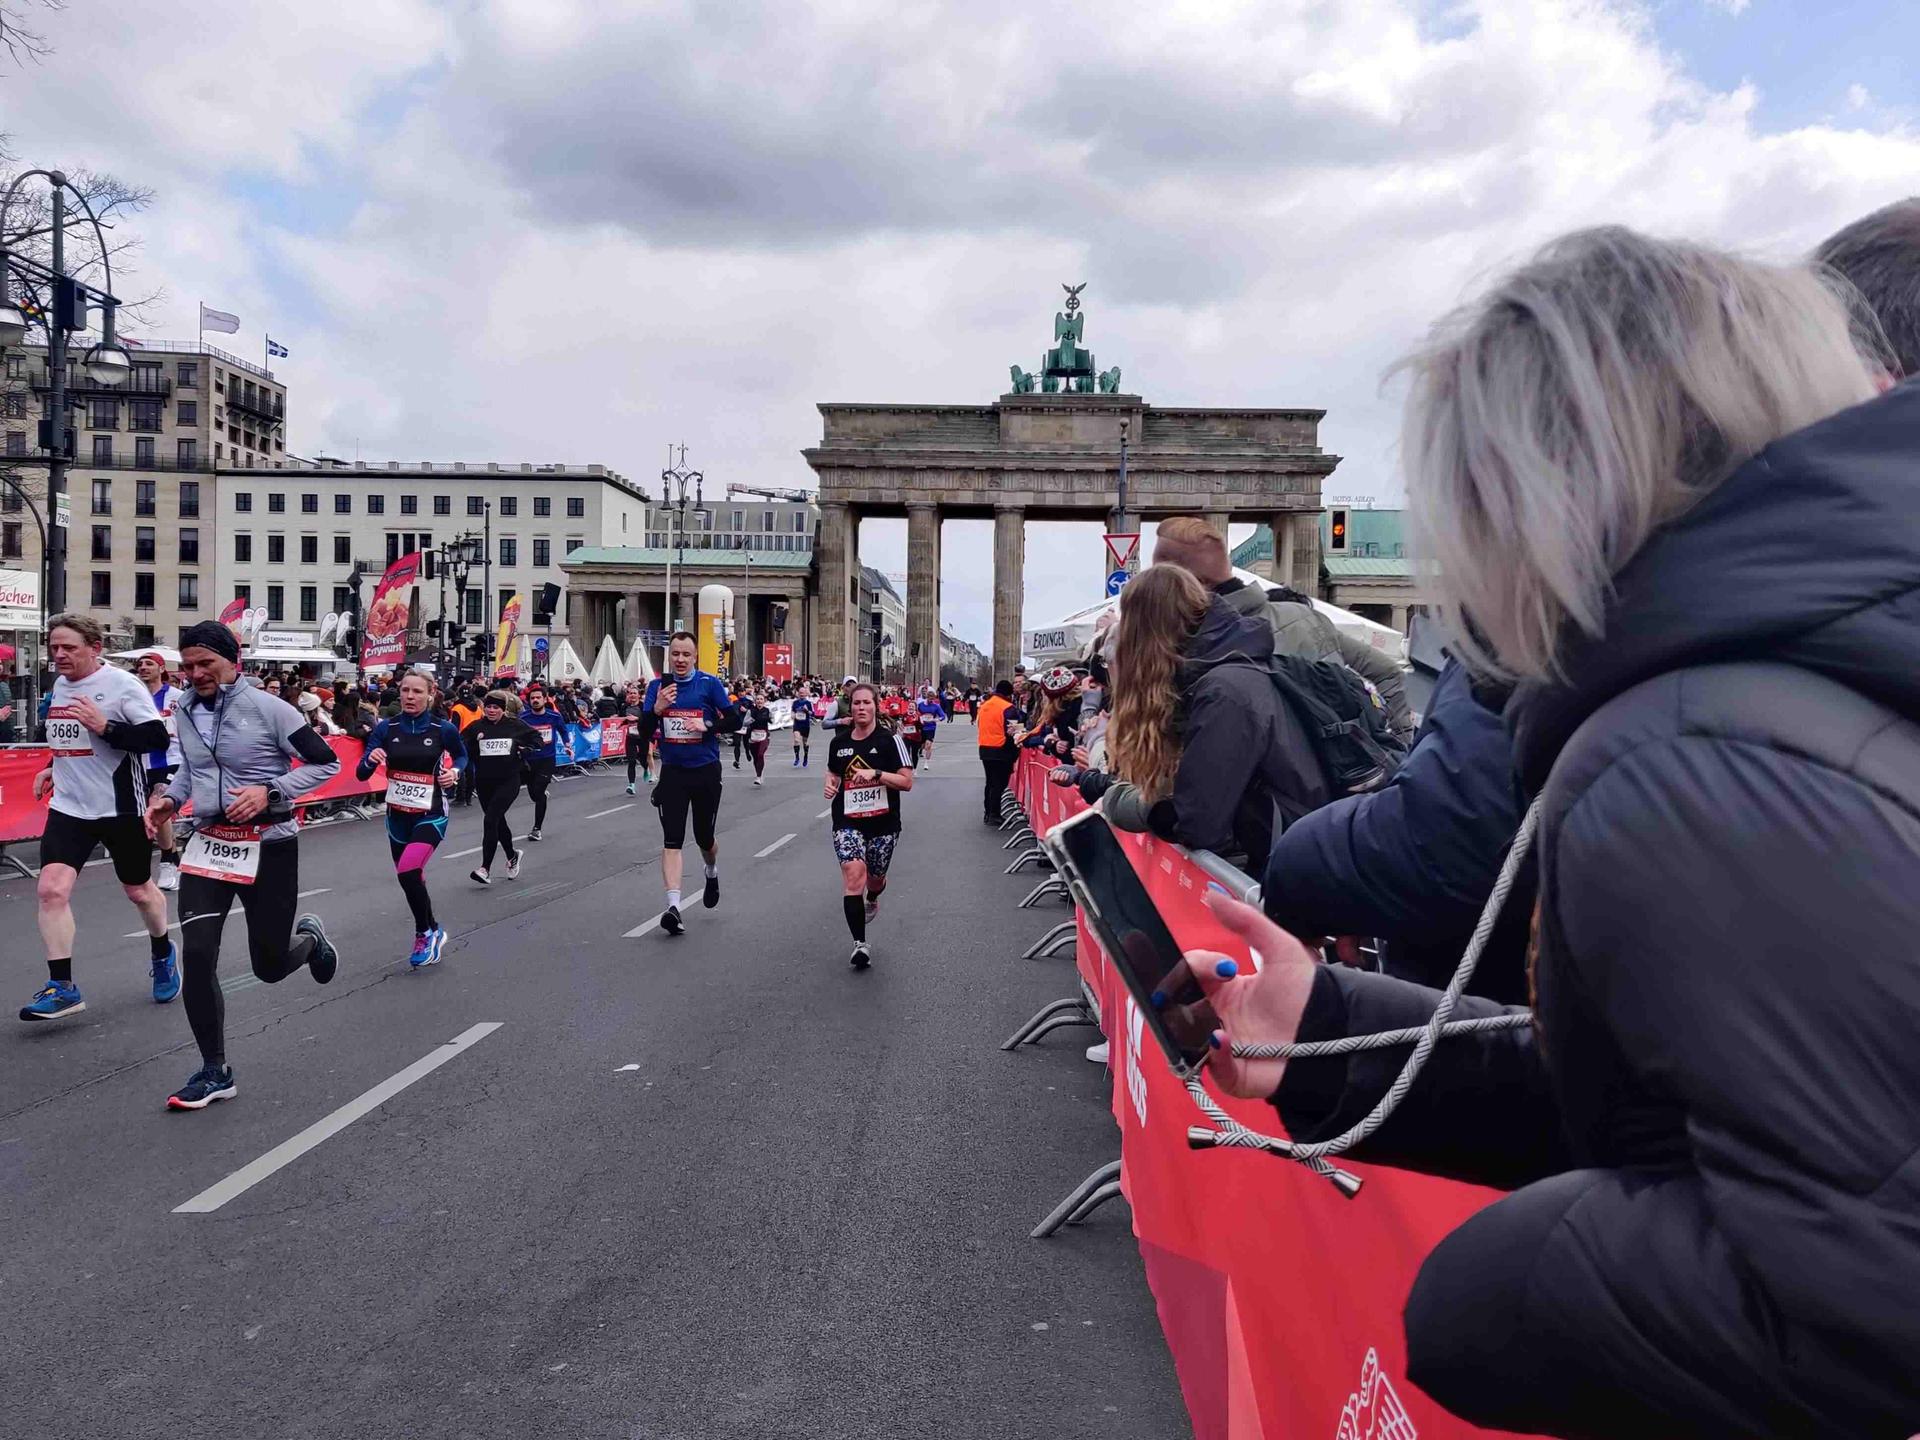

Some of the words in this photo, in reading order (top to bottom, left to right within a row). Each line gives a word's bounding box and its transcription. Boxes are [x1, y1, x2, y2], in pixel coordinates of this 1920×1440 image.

[1033, 631, 1067, 650] ERDINGER
[776, 653, 790, 665] 21
[51, 723, 80, 739] 3689
[485, 741, 509, 749] 52785
[394, 783, 427, 798] 23852
[852, 788, 881, 804] 33841
[209, 827, 249, 840] GENERALI
[204, 840, 250, 861] 18981
